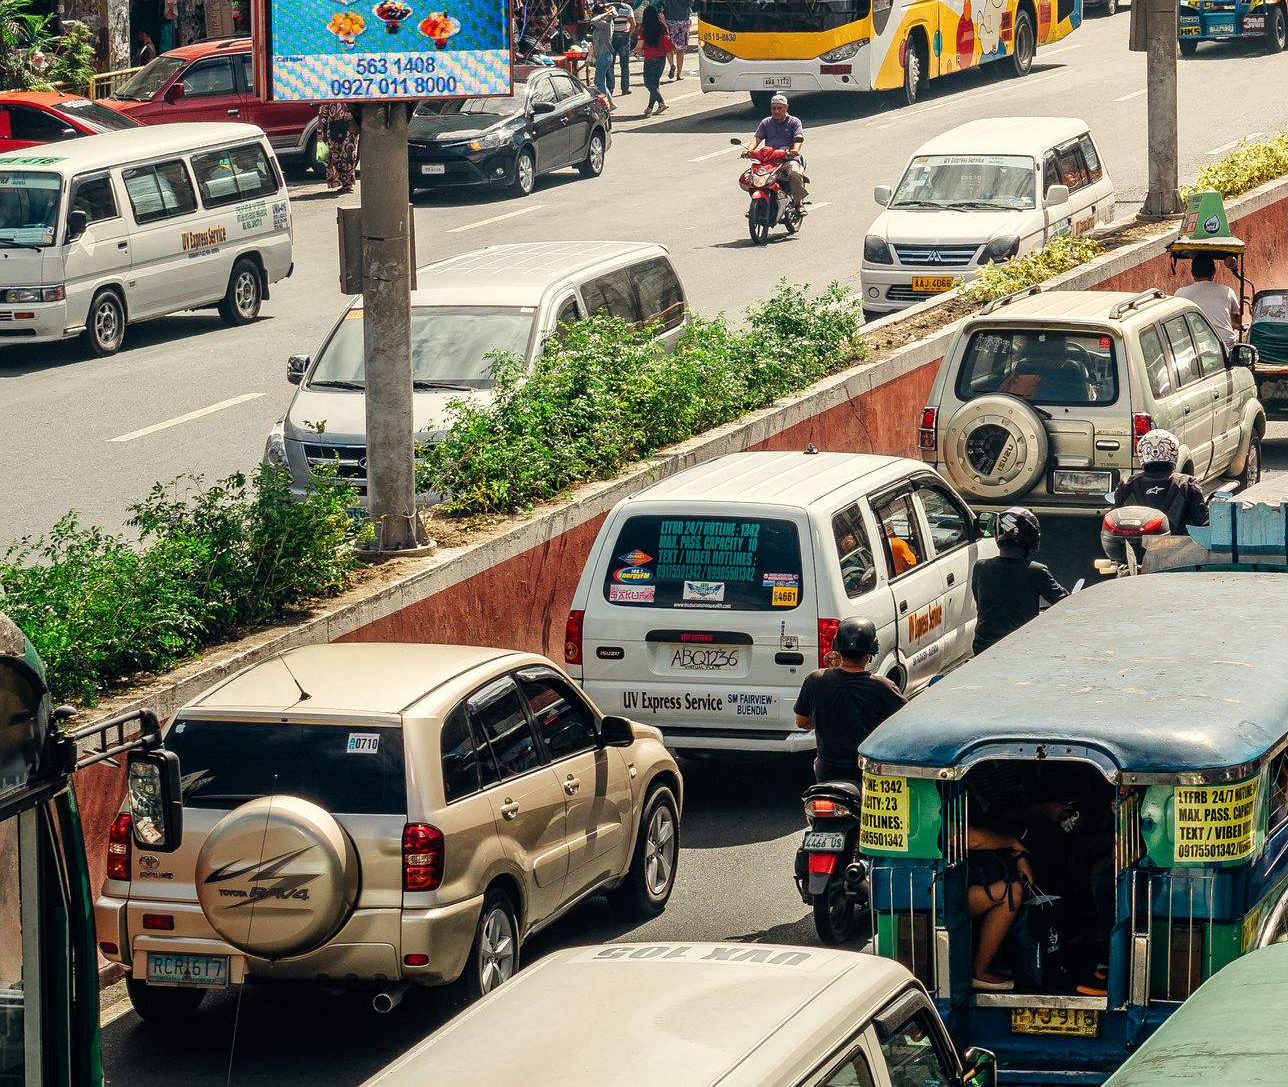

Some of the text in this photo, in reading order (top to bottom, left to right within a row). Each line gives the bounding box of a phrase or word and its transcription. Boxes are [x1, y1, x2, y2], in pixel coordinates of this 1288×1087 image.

[704, 33, 737, 42] 0515-8830
[356, 57, 435, 75] 563 1408
[331, 76, 457, 96] 0927 011 8000
[996, 444, 1014, 472] ISUZU
[660, 521, 684, 535] LTFRB
[684, 522, 703, 536] 24/7
[740, 523, 760, 538] 1342
[658, 536, 758, 551] MAX. PASS. CAPACITY 10
[776, 591, 796, 602] 4661
[670, 649, 738, 667] ABQ1236
[623, 692, 639, 709] UV
[641, 692, 682, 713] Express
[685, 693, 723, 711] Service
[727, 694, 739, 704] SM
[740, 694, 773, 705] FAIRVIEW
[737, 705, 768, 716] BUENDIA
[880, 780, 903, 793] 1342
[885, 798, 898, 811] 23
[1178, 790, 1208, 805] LTFRB
[1212, 788, 1234, 804] 24/7
[1178, 806, 1232, 822] MAX. PASS.
[218, 886, 309, 901] TOYOTA RAV4
[153, 955, 222, 977] RCR 617
